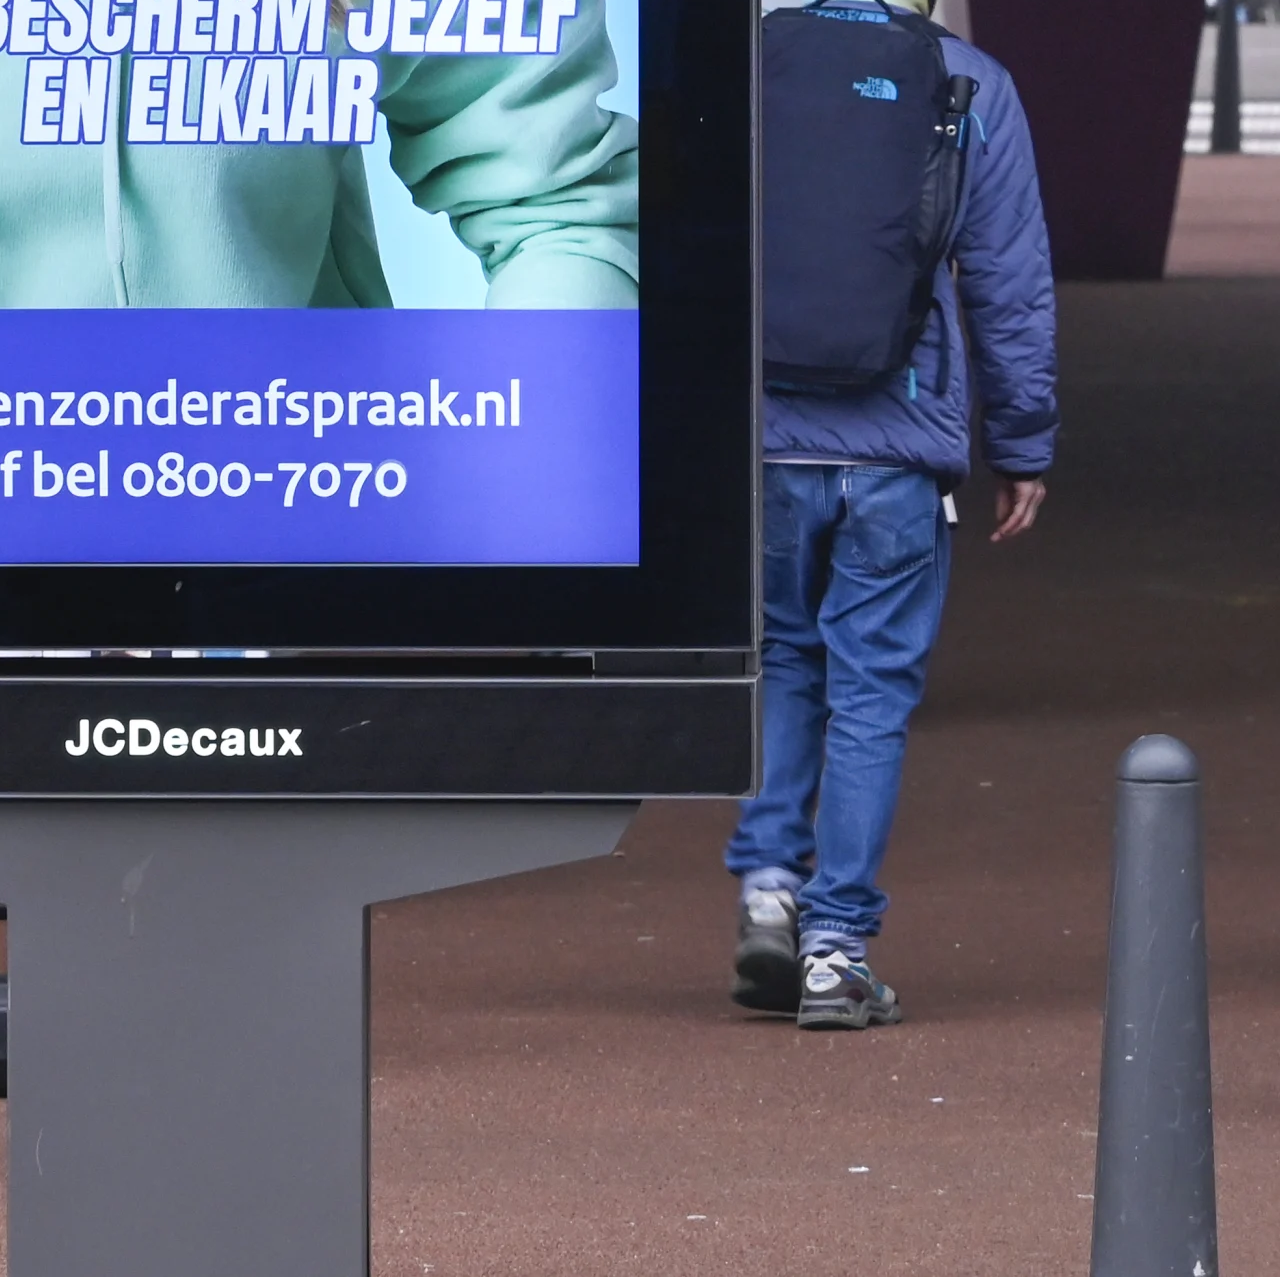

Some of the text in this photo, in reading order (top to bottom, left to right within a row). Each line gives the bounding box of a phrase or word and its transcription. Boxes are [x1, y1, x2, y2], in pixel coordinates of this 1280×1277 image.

[20, 57, 380, 145] EN ELKAAR
[852, 81, 882, 93] NORTH
[860, 88, 882, 99] FACE
[34, 449, 109, 499] bel
[122, 451, 408, 508] 0800-7070
[65, 718, 304, 758] JCDecaux
